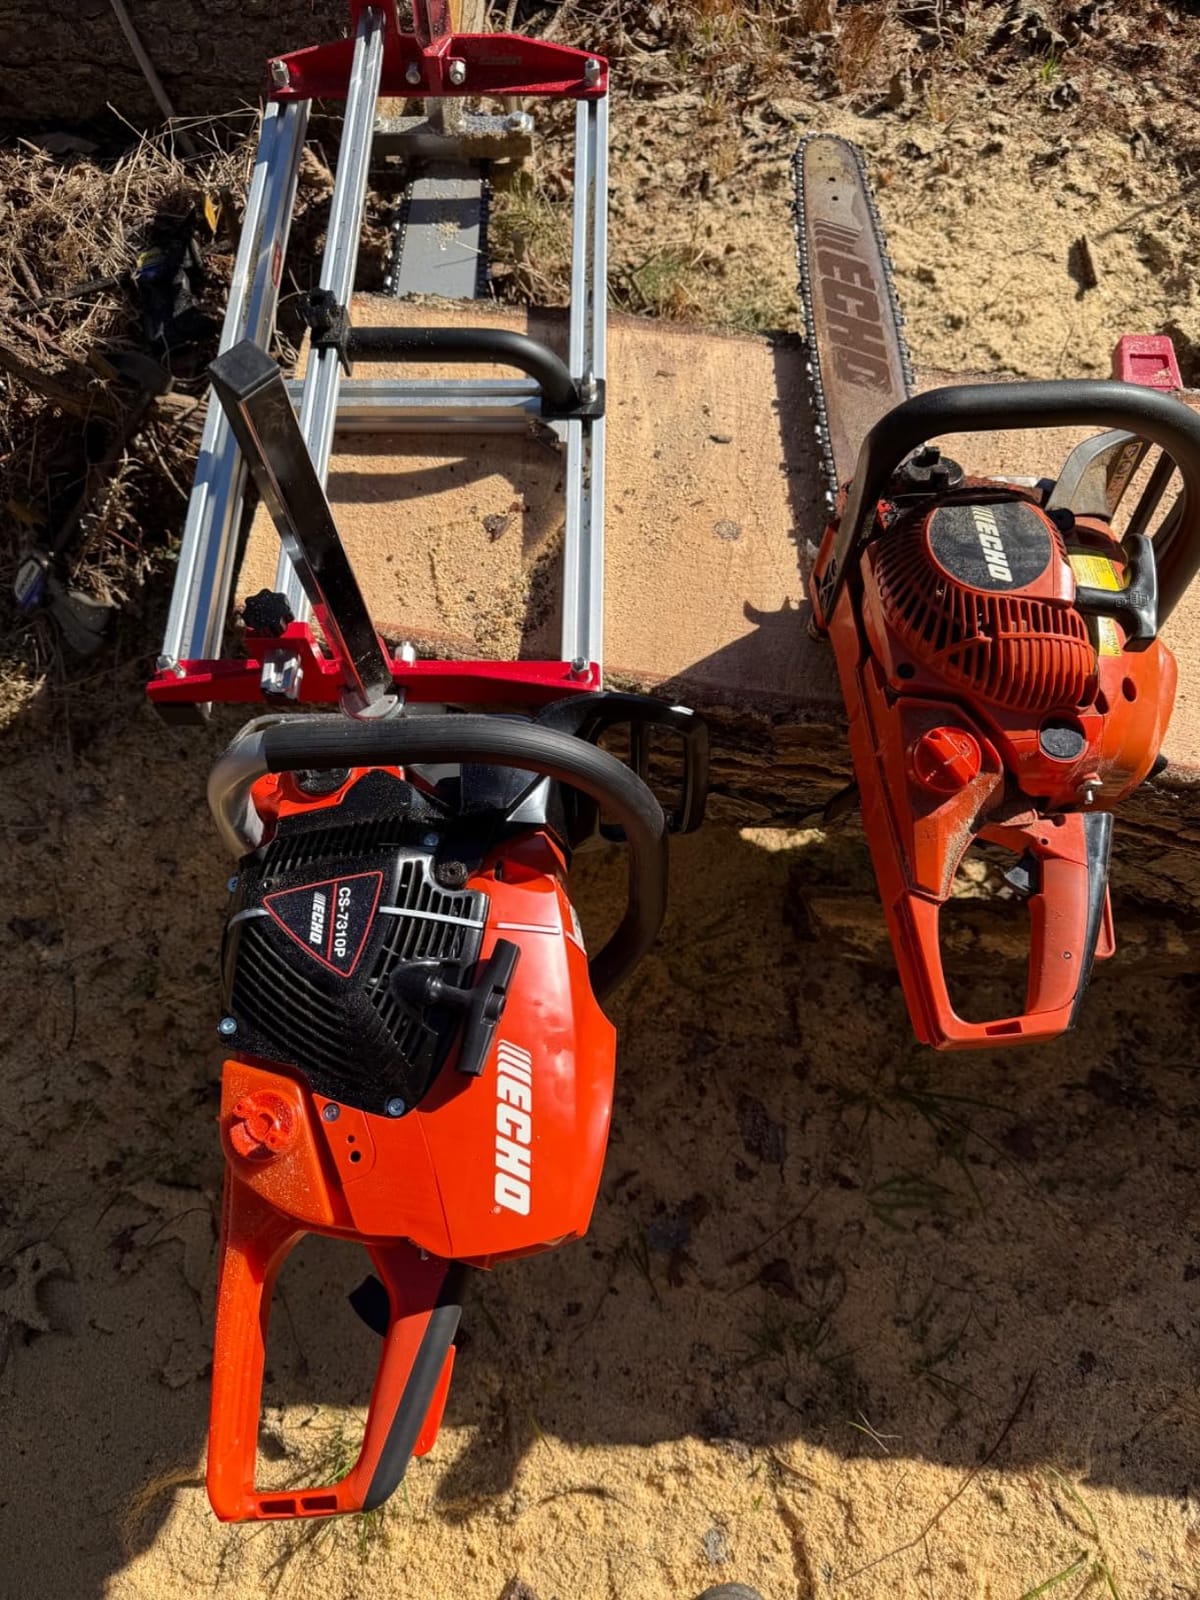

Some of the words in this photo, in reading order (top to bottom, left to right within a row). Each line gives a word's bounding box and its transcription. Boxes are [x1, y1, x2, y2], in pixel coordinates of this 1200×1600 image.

[816, 249, 893, 394] ECHO
[975, 519, 1013, 582] ECHO
[309, 901, 326, 945] ECHO
[334, 887, 351, 957] CS-7310P
[495, 1073, 532, 1216] ECHO
